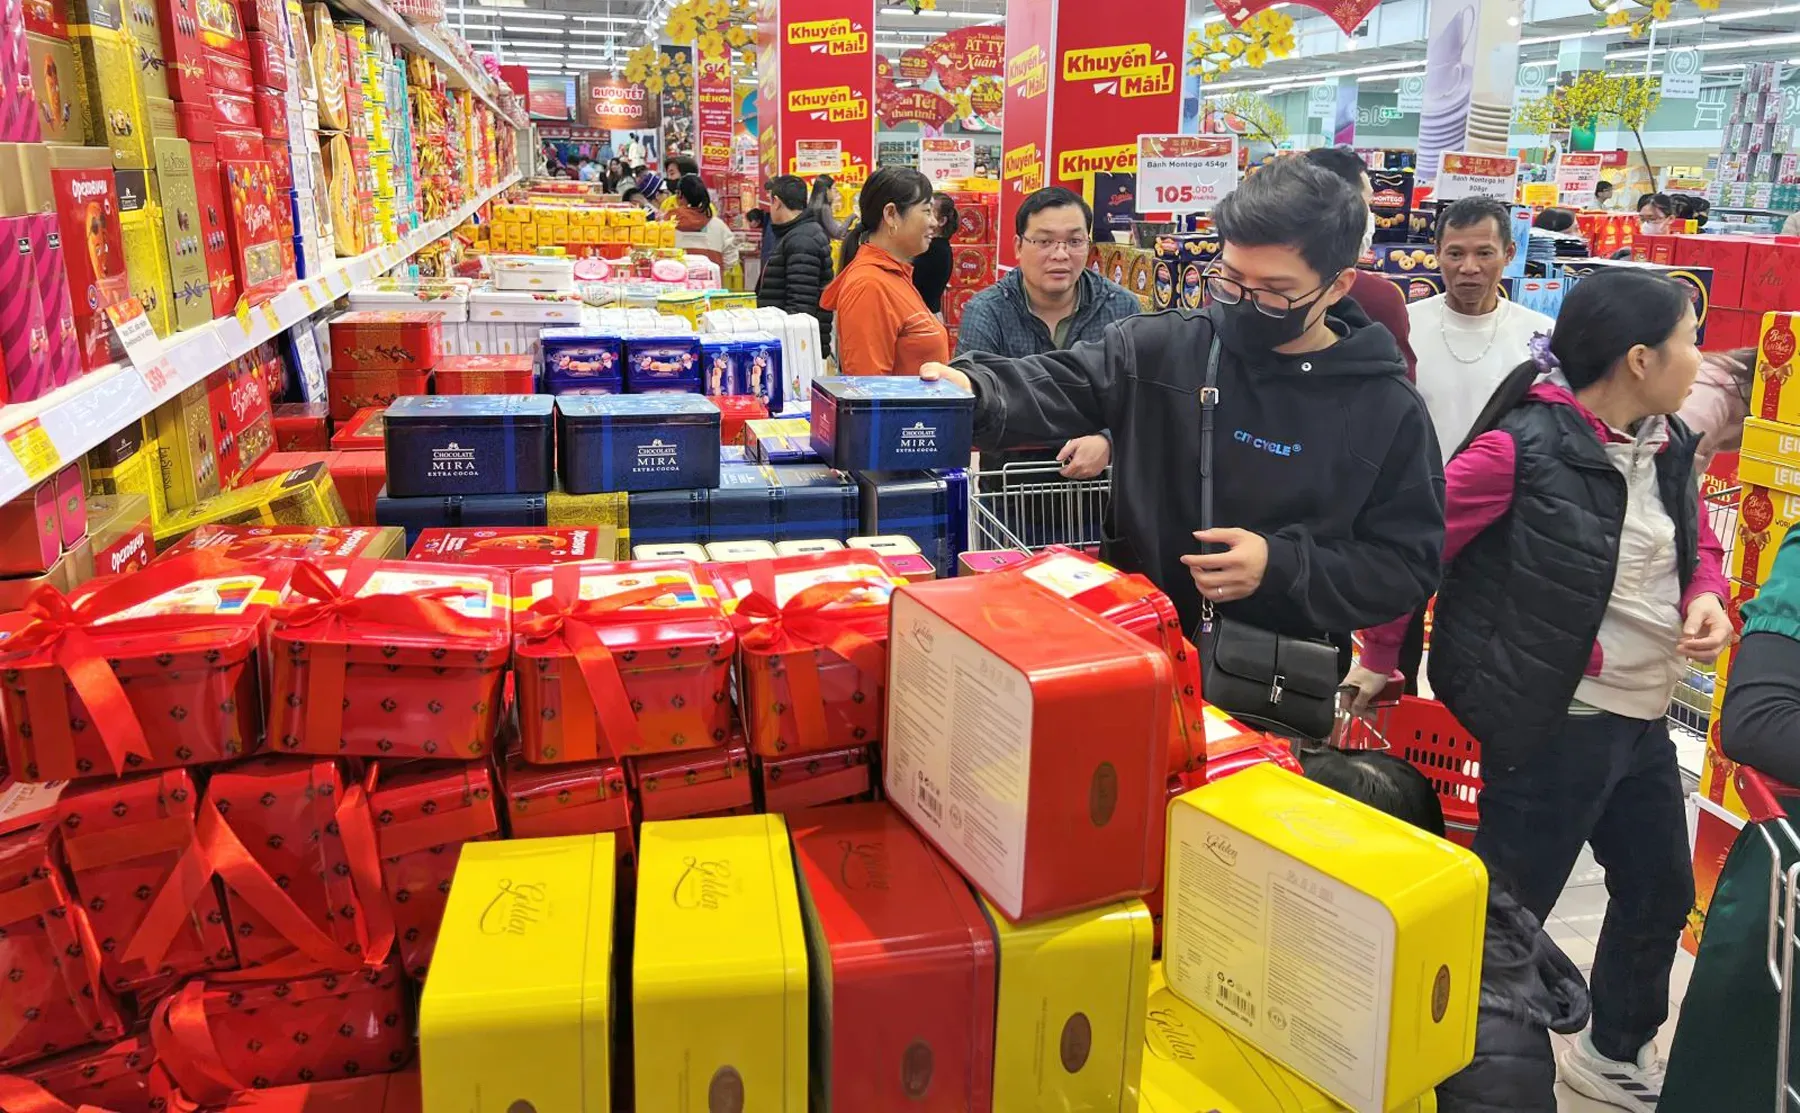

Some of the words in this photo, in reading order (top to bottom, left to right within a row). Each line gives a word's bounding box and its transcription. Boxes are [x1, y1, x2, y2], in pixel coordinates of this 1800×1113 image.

[791, 22, 847, 40] Khuyến
[833, 34, 865, 53] Mãi!
[955, 54, 997, 70] Xuân
[1008, 52, 1039, 77] Khuyến
[1067, 48, 1146, 74] Khuyến
[1125, 65, 1171, 95] Mãi!
[625, 83, 645, 100] TẾT
[791, 89, 847, 107] Khuyến
[596, 103, 617, 115] CÁC
[619, 104, 642, 118] LOẠI
[833, 101, 865, 120] Mãi!
[1006, 151, 1034, 173] Khuyến
[1147, 160, 1166, 168] Bánh
[1169, 160, 1202, 168] Montego
[1205, 160, 1228, 168] 454gr
[1469, 176, 1496, 184] Montego
[1155, 185, 1192, 203] 105
[1410, 286, 1428, 294] NTEGO
[638, 447, 677, 455] CHOCOLATE
[901, 439, 936, 447] MIRA
[1779, 435, 1800, 453] LEI
[433, 451, 475, 459] CHOCOLATE
[637, 457, 677, 466] MIRA
[433, 462, 475, 470] MIRA
[1775, 467, 1800, 485] LEIB
[1783, 494, 1800, 518] LE
[480, 878, 547, 937] Golden
